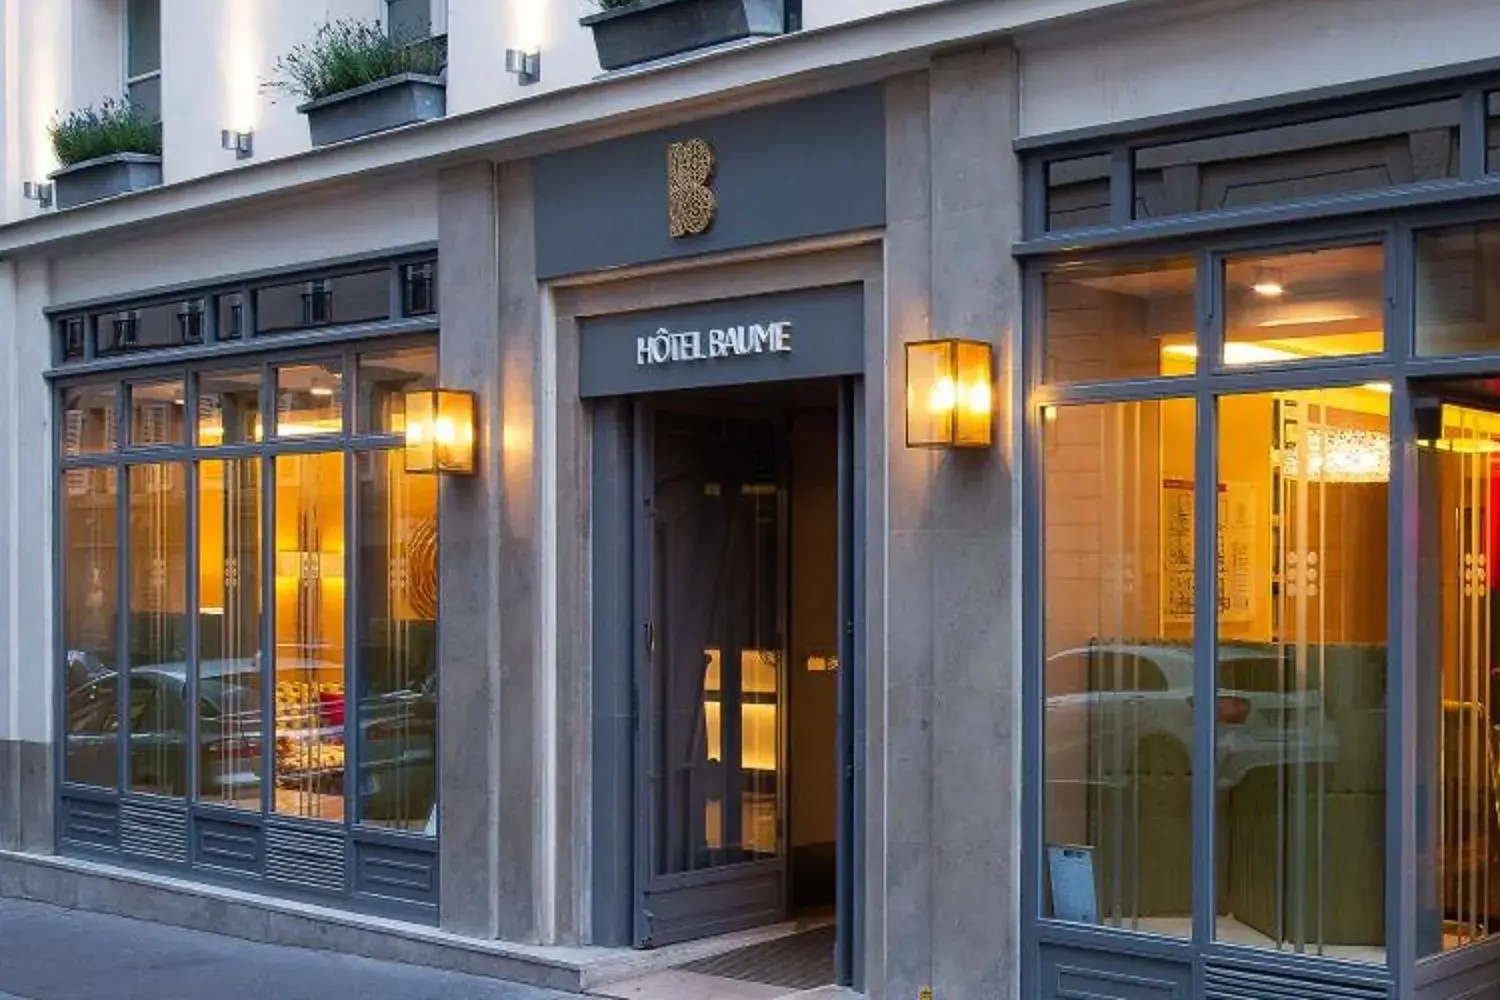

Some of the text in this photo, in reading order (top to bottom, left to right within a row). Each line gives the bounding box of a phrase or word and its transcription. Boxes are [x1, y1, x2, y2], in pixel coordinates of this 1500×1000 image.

[667, 138, 716, 238] B
[637, 321, 792, 365] HÔTEL BAUME
